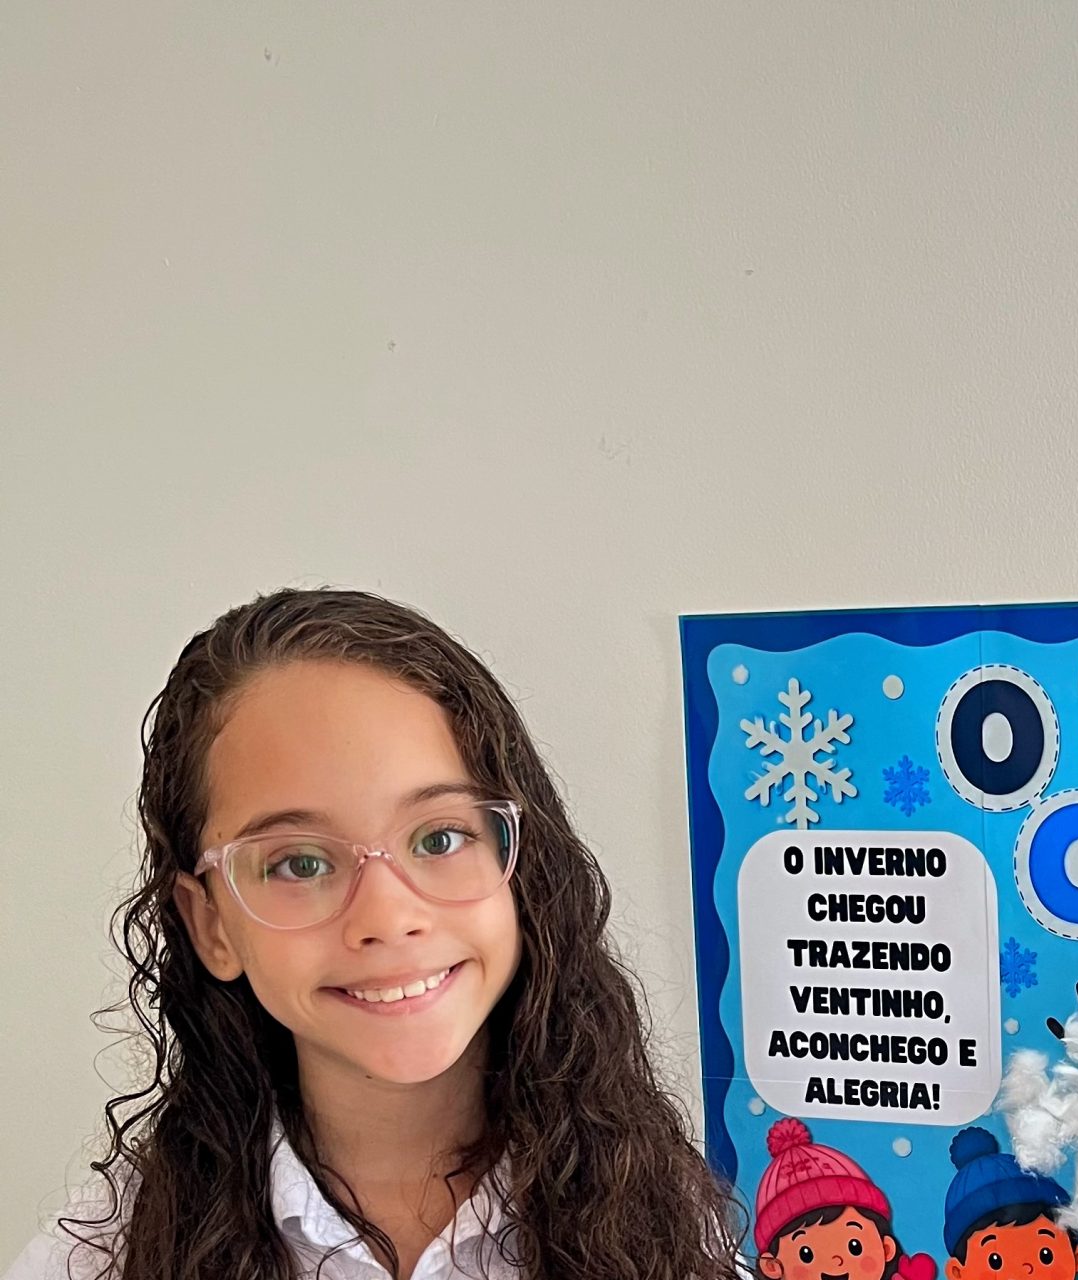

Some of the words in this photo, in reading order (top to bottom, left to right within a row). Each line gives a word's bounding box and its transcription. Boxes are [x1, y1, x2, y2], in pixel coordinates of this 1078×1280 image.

[949, 678, 1045, 795] O
[783, 846, 804, 875] O
[814, 846, 947, 877] INVERNO
[807, 893, 926, 924] CHEGOU
[786, 939, 952, 973] TRAZENDO
[789, 985, 951, 1024] VENTINHO,
[768, 1030, 949, 1066] ACONCHEGO
[959, 1038, 977, 1067] E
[804, 1076, 941, 1110] ALEGRIA!
